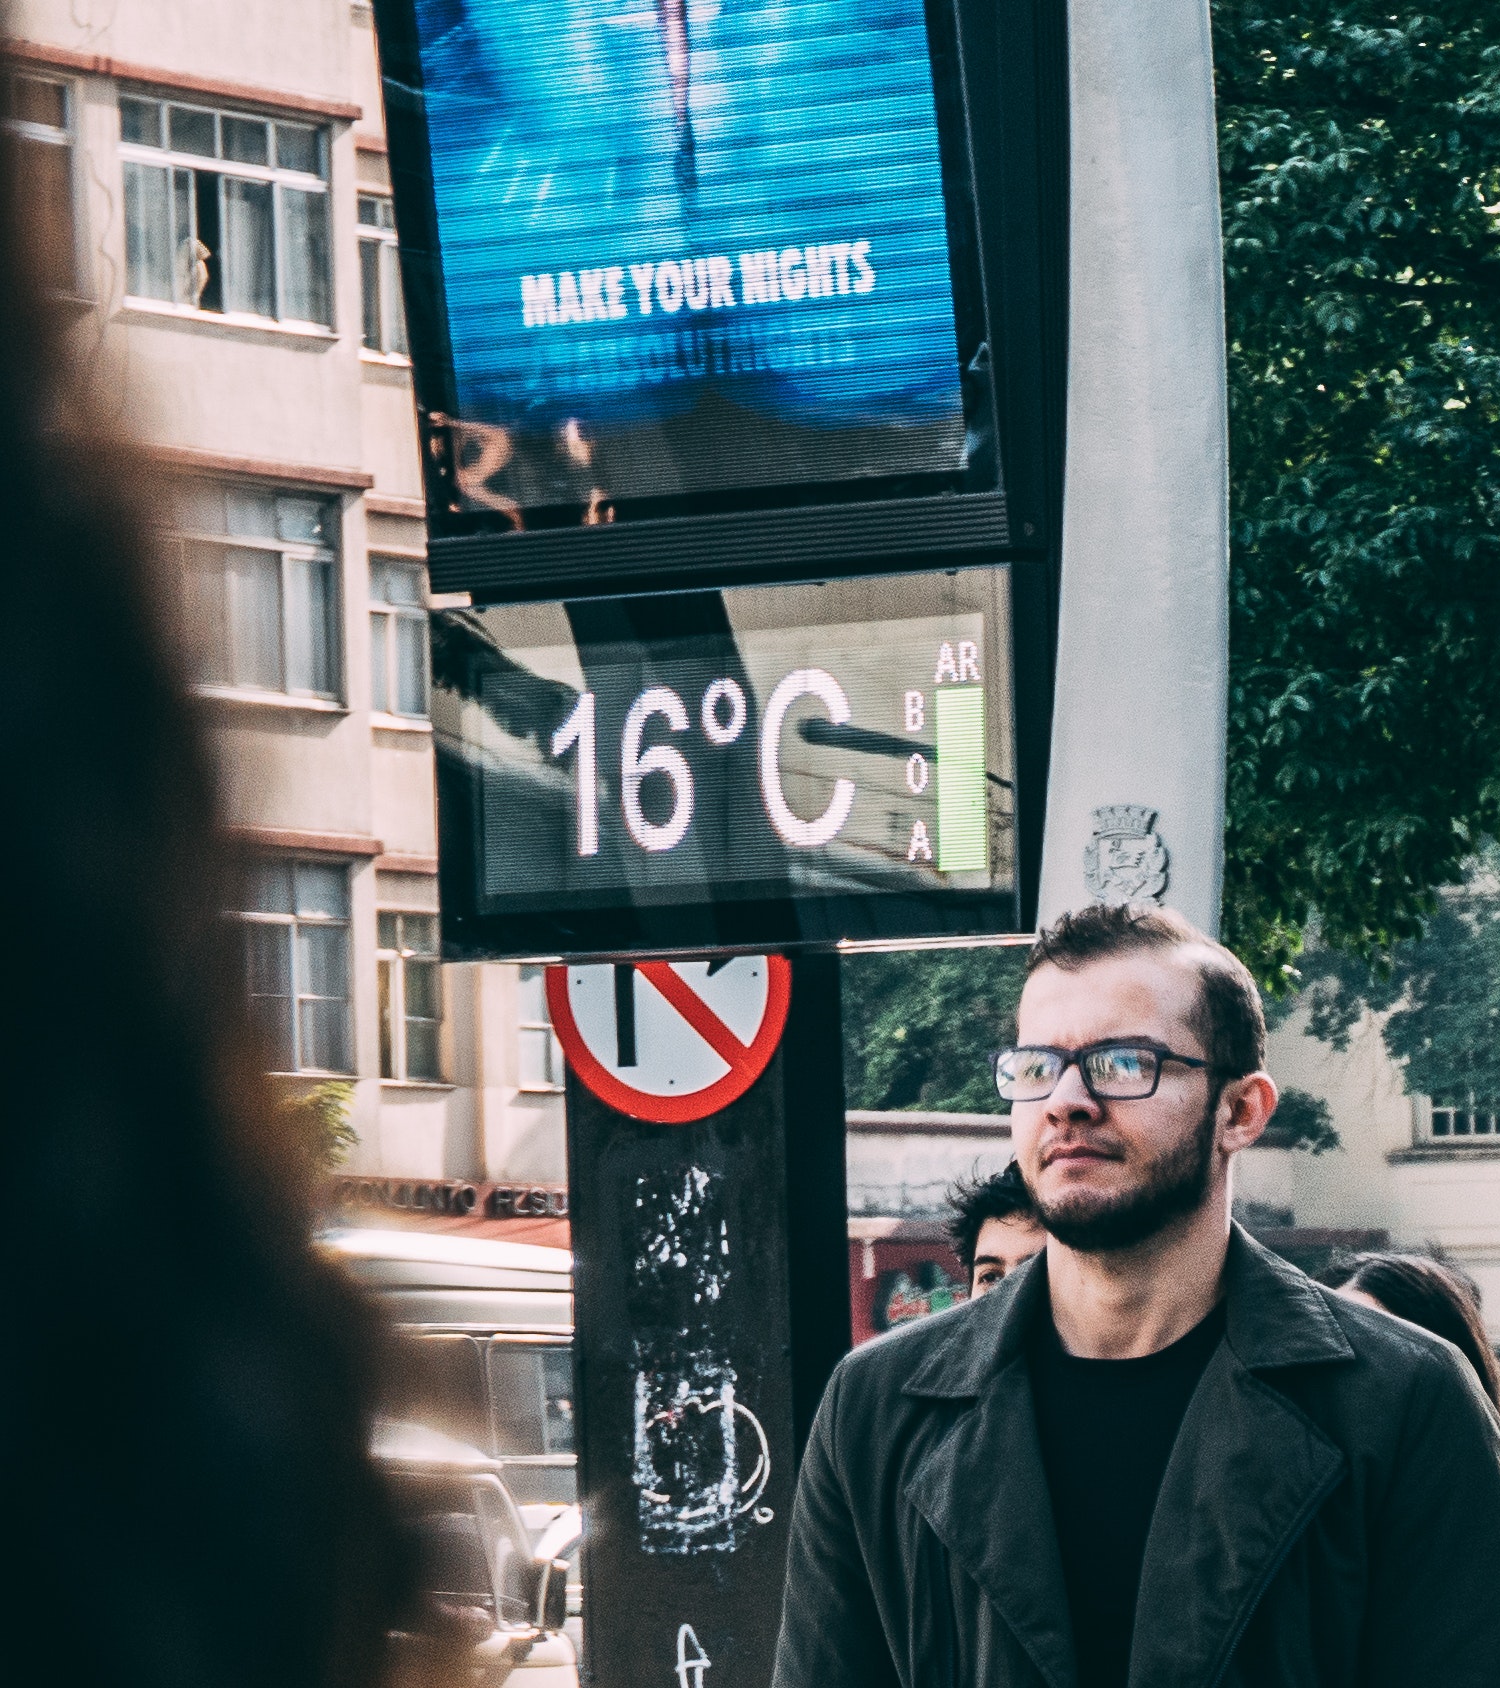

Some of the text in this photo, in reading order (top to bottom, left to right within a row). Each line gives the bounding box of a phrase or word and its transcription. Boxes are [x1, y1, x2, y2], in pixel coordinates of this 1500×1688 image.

[520, 238, 877, 328] MAKE YOUR NIGHTS
[935, 641, 982, 683] AR
[551, 667, 856, 858] 16°C
